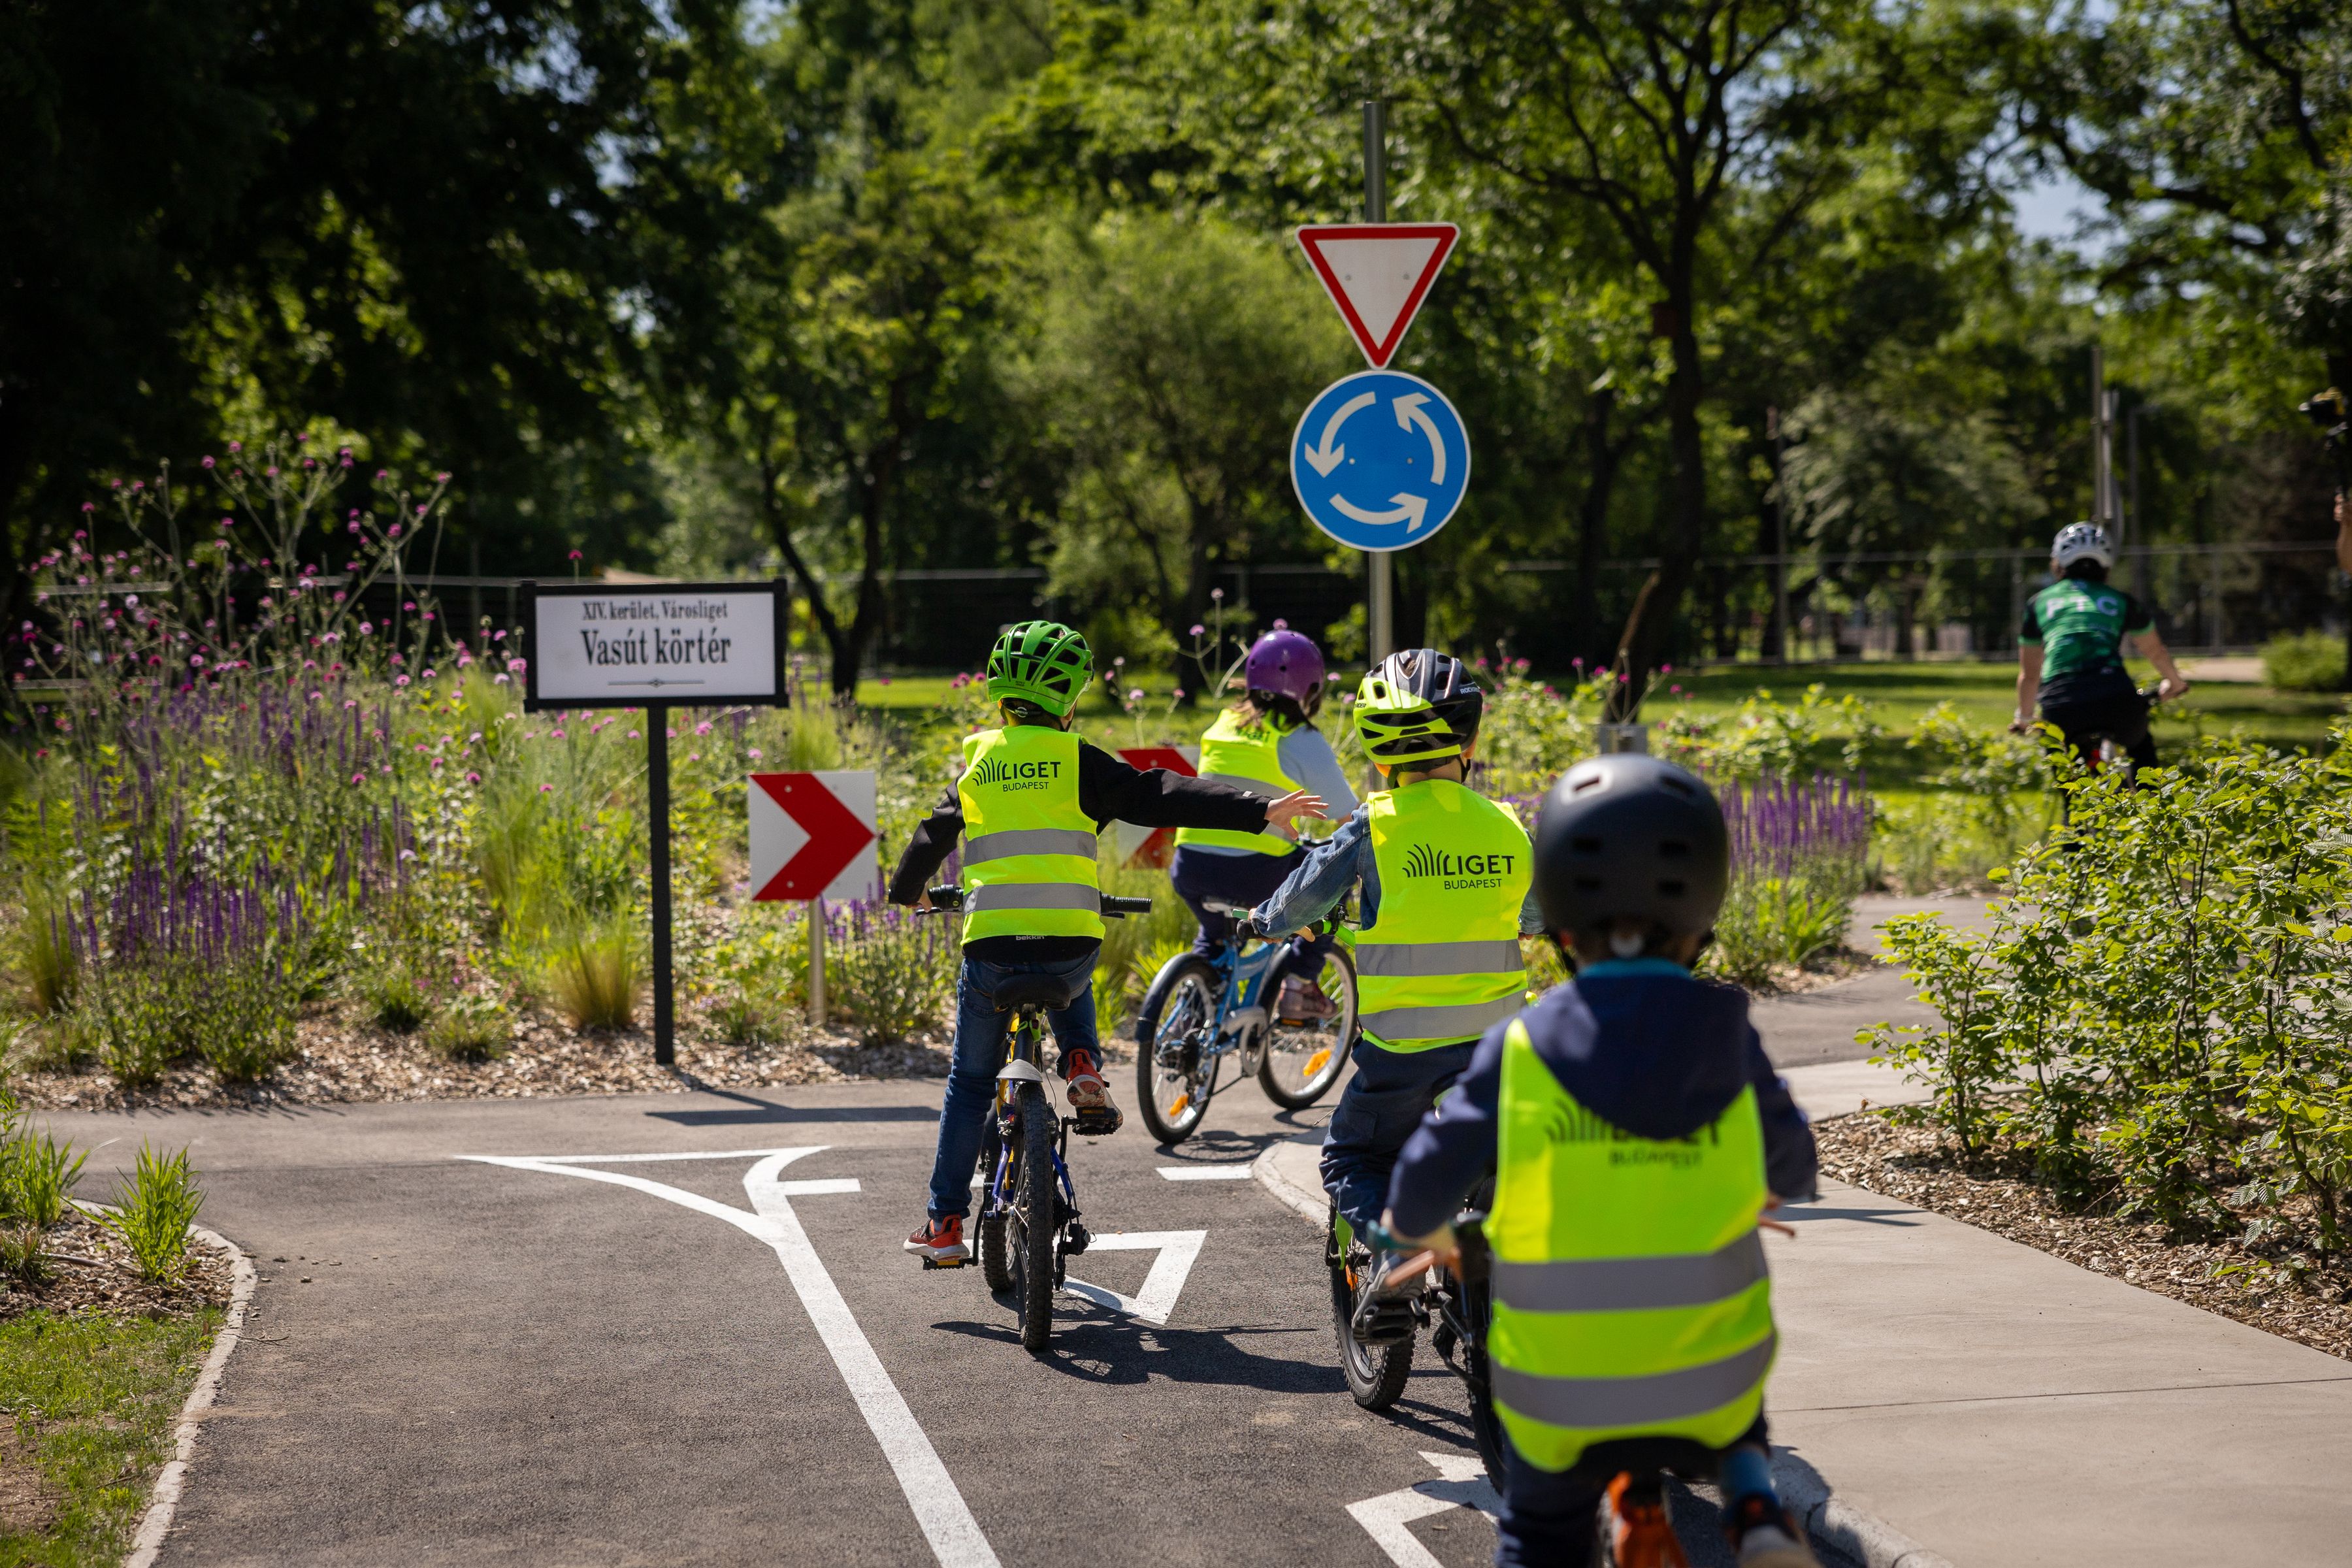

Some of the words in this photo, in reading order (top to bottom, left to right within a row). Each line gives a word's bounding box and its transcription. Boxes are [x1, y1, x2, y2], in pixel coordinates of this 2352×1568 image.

[583, 601, 606, 620] XIV.
[610, 600, 659, 621] kerület,
[661, 599, 728, 623] Városliget
[580, 627, 649, 665] Vasút
[655, 625, 731, 664] körtér
[1002, 761, 1061, 781] LIGET
[1003, 781, 1049, 792] BUDAPEST
[1443, 854, 1514, 876] LIGET
[1444, 878, 1502, 890] BUDAPEST
